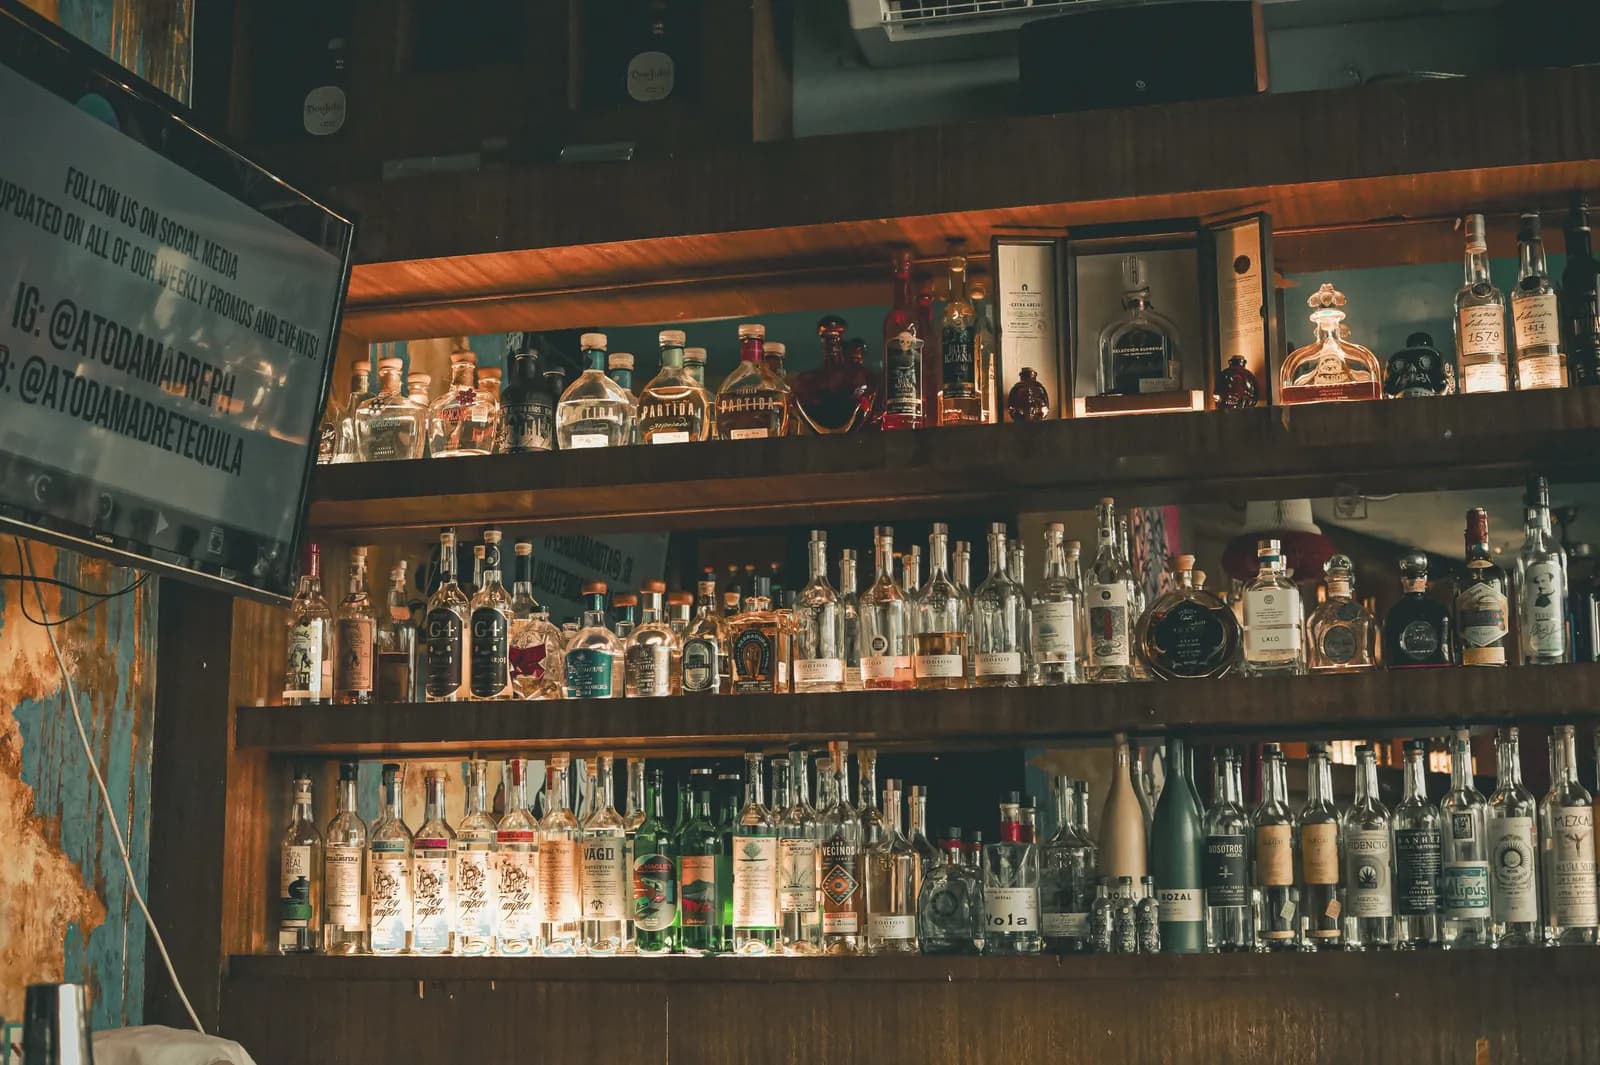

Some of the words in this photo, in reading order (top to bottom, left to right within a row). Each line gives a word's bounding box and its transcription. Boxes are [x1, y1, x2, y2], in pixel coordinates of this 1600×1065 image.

[64, 166, 120, 218] FOLLOW
[120, 195, 139, 228] US
[139, 206, 159, 238] ON
[159, 217, 200, 261] SOCIAL
[201, 239, 239, 280] MEDIA
[63, 213, 85, 246] ON
[85, 224, 109, 259] ALL
[112, 236, 131, 269] OF
[131, 246, 158, 281] OUR
[158, 260, 208, 305] WEEKLY
[207, 285, 255, 328] PROMOS
[254, 309, 278, 339] AND
[277, 319, 320, 361] EVENTS!
[1467, 331, 1500, 343] 1579
[12, 281, 45, 337] IG:
[49, 298, 237, 415] @ATODAMADREPH
[642, 402, 695, 418] PARTIDA
[721, 396, 775, 413] PARTIDA
[18, 355, 244, 477] @ATODAMADRETEQUILA
[1261, 635, 1280, 643] LALO
[1554, 815, 1592, 827] MEZCAL
[823, 846, 855, 856] VECINOS
[1209, 845, 1243, 855] NOSOTROS
[1160, 893, 1192, 901] BOZAL
[986, 912, 1027, 926] Yola
